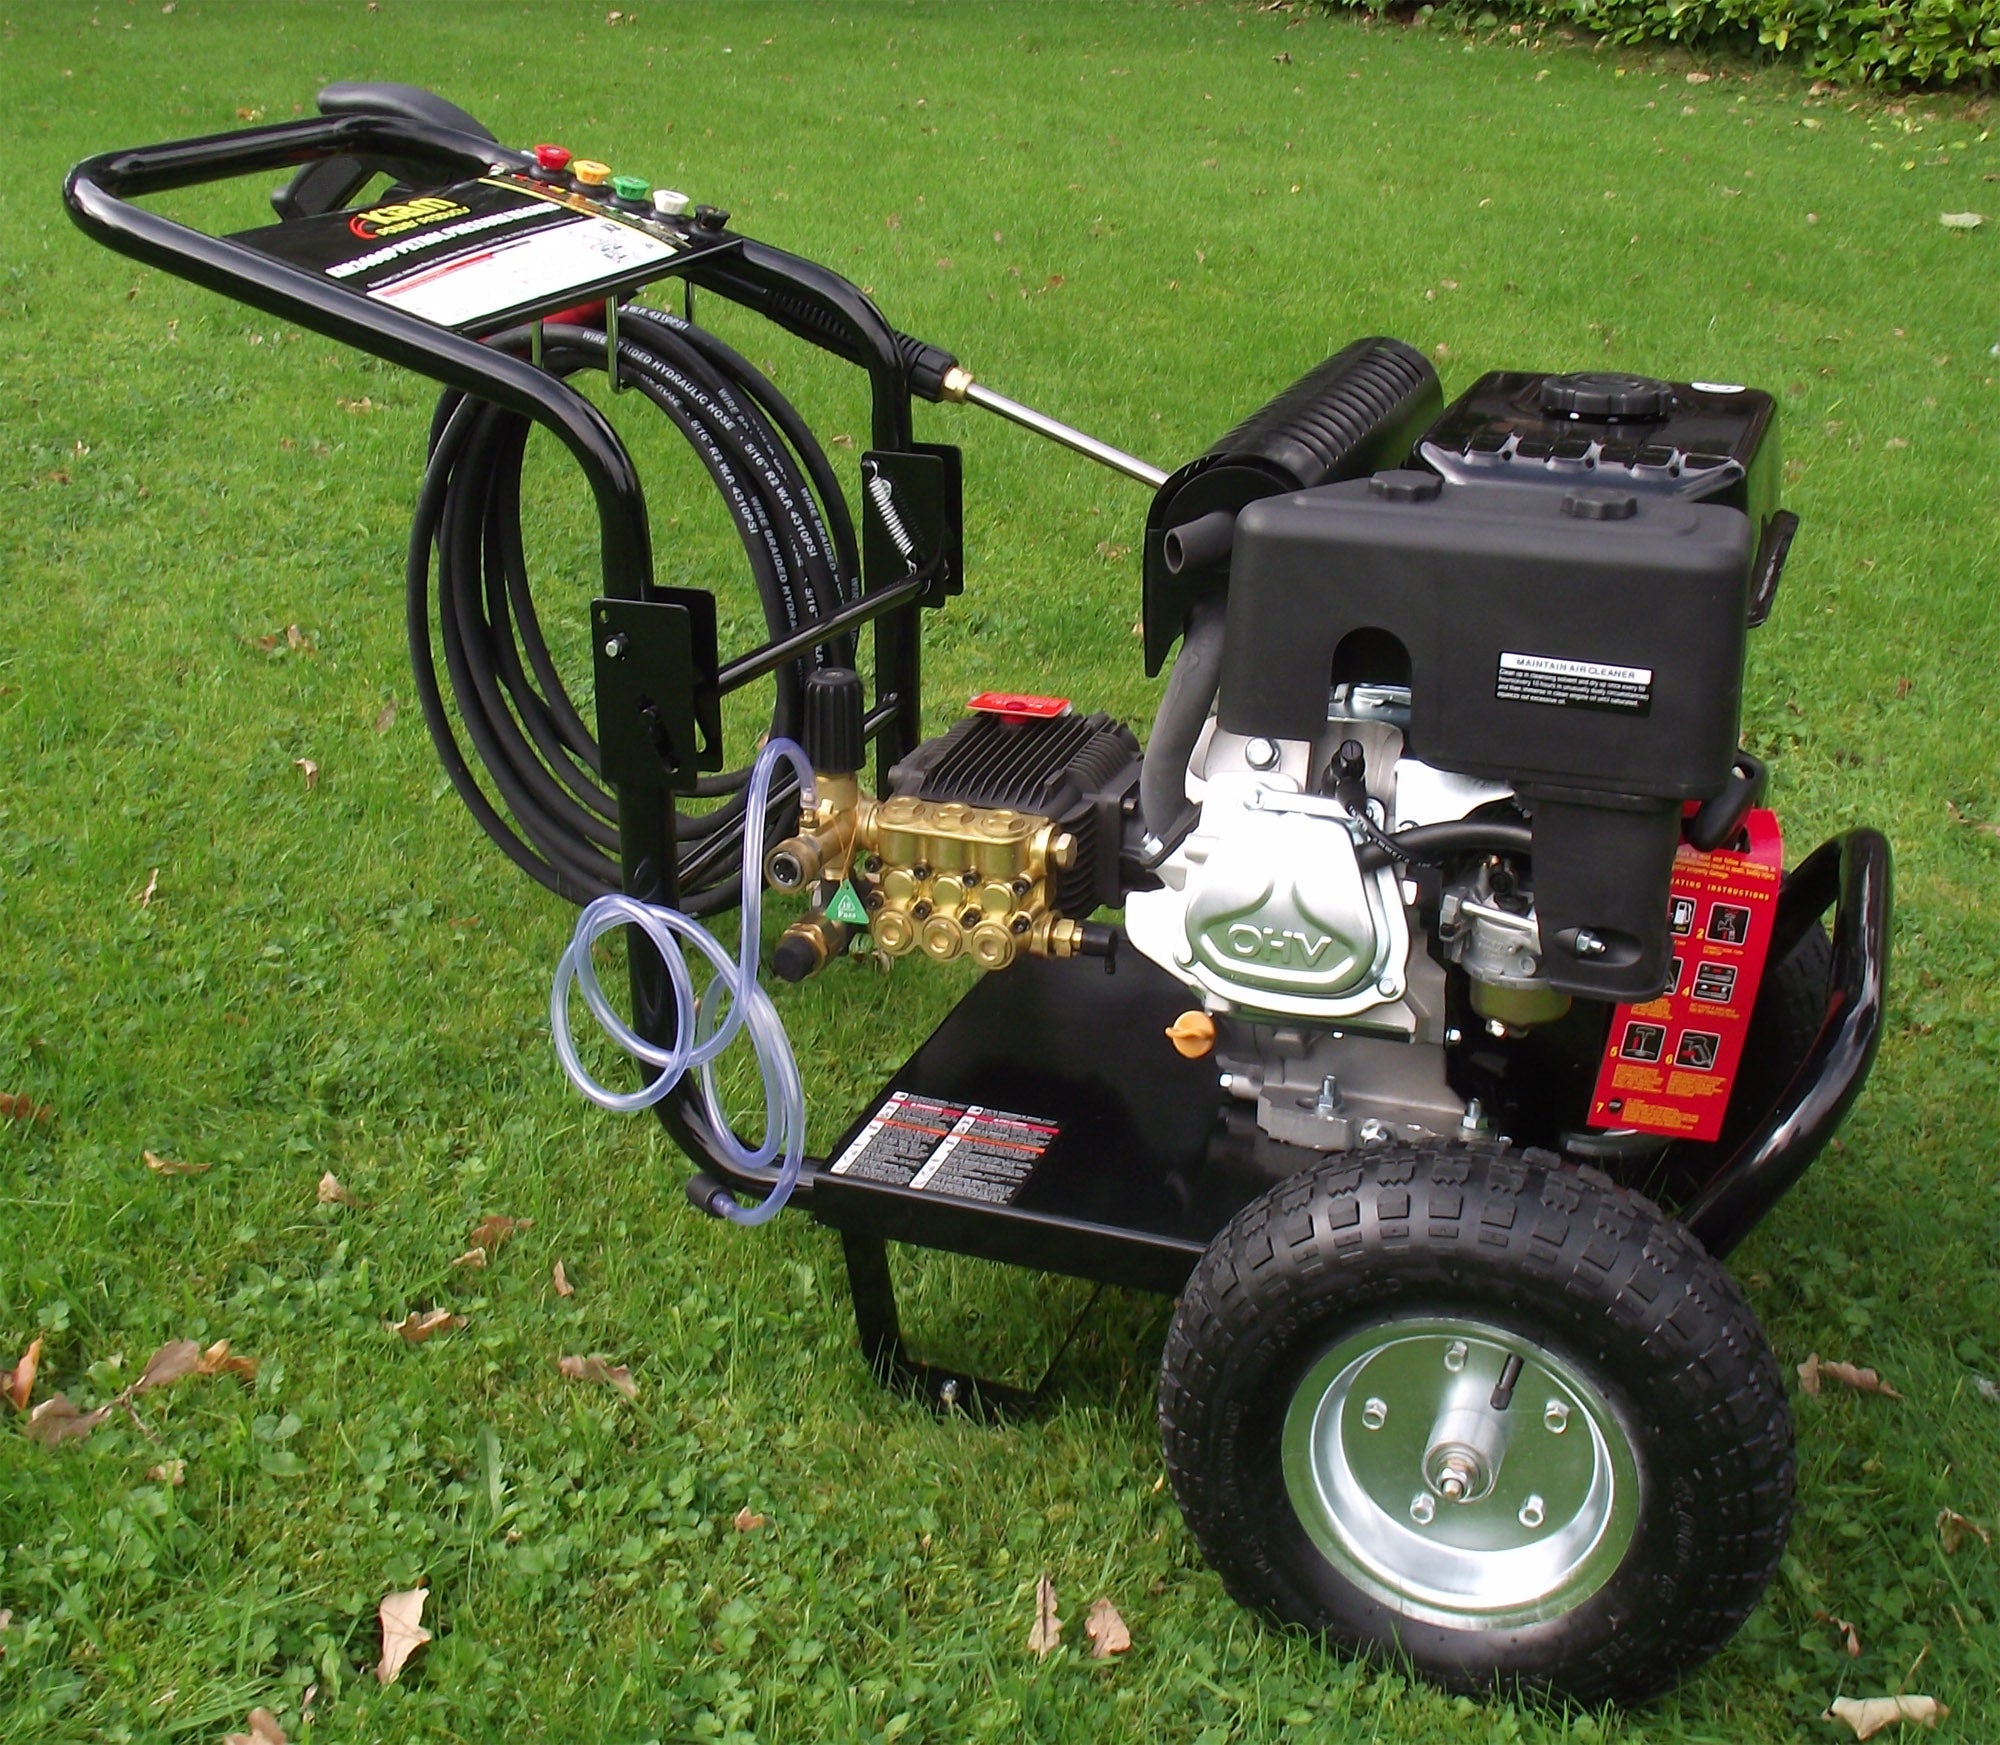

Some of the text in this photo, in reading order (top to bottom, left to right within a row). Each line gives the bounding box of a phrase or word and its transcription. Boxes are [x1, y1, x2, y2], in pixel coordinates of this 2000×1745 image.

[718, 388, 740, 414] WIRE
[708, 446, 723, 462] R2
[732, 486, 759, 534] 4310PSI
[765, 470, 780, 488] R2
[790, 511, 818, 558] 4310PSI
[750, 496, 770, 527] WIRE
[764, 530, 788, 583] BRAIDED
[801, 487, 837, 571] WIRE BRAIDED
[1516, 658, 1636, 680] MAINTAIN AIR CLEANER
[1707, 883, 1770, 901] INSTRUCTIONS
[1228, 922, 1332, 968] OHV
[1696, 928, 1705, 940] 2
[1682, 986, 1690, 997] 4
[1596, 1102, 1605, 1113] 7
